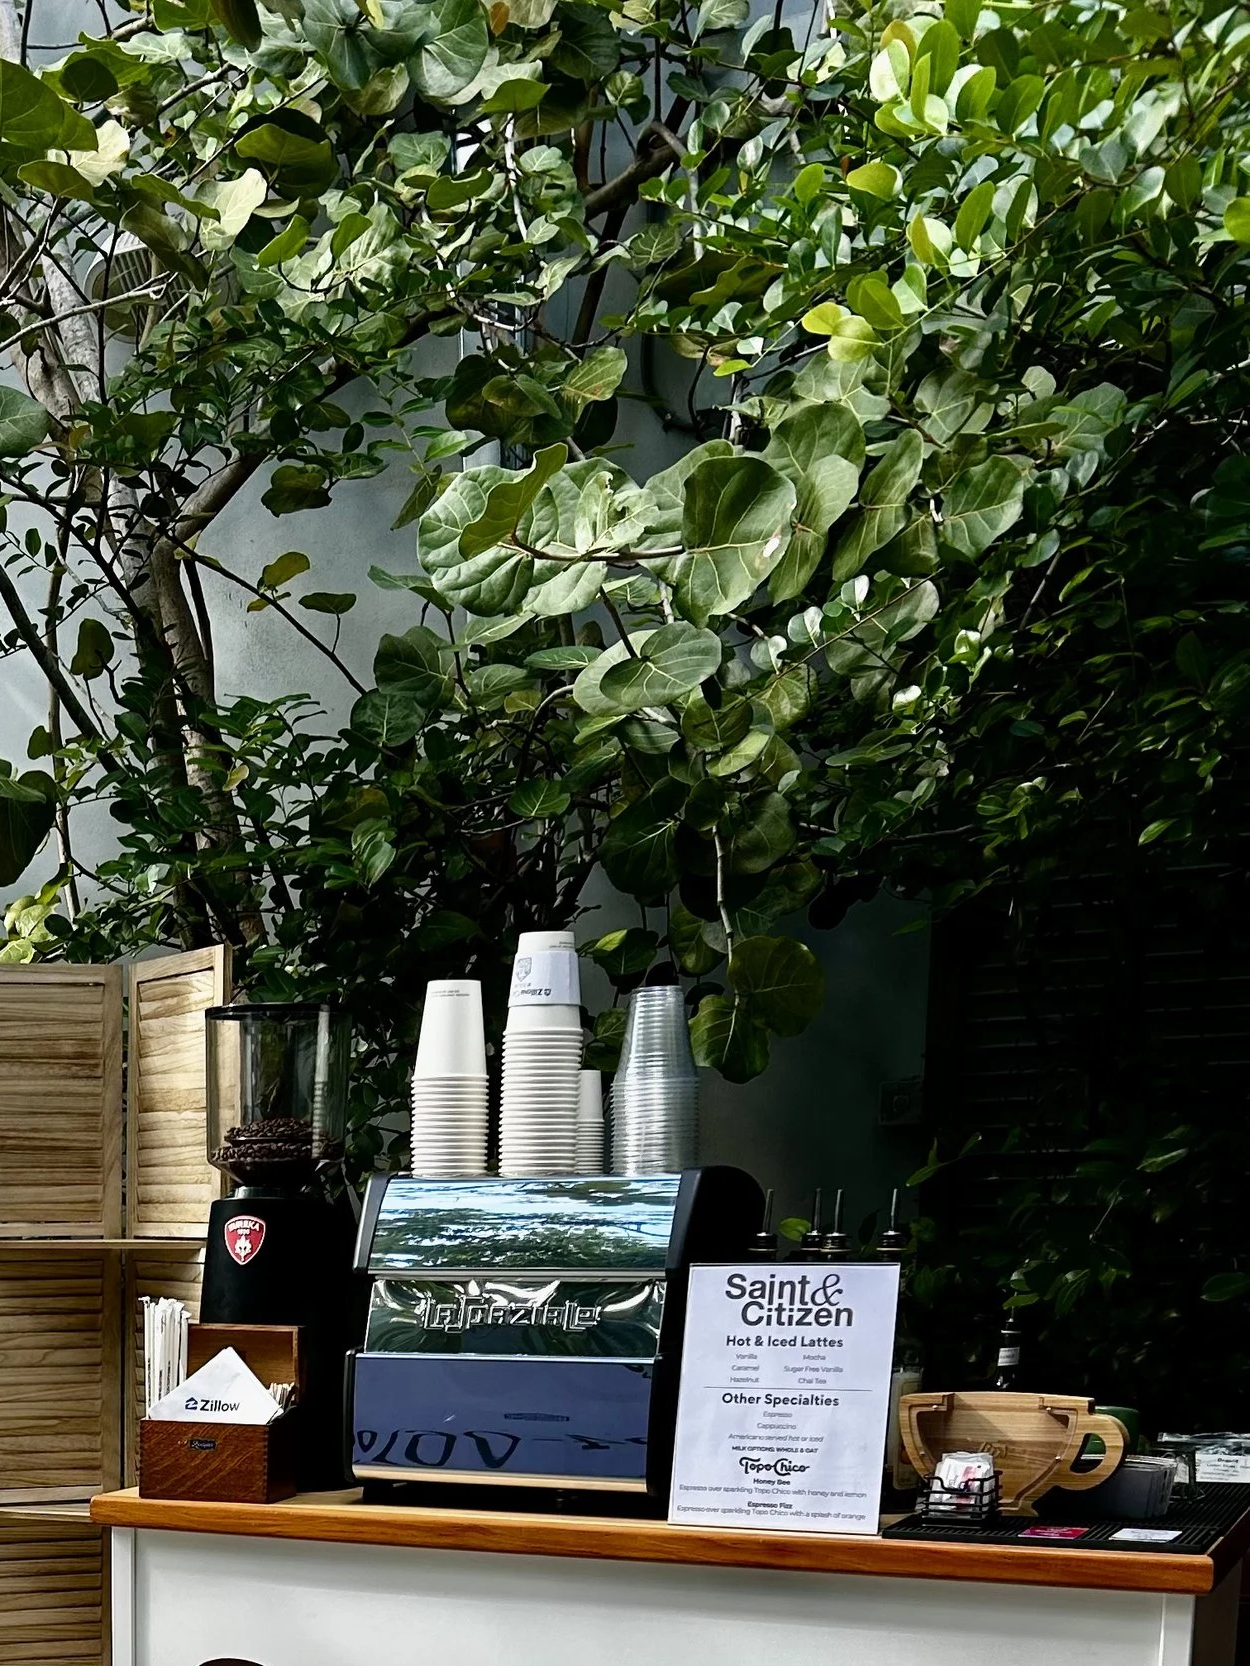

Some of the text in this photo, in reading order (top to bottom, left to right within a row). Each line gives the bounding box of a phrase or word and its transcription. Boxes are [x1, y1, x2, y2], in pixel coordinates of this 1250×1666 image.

[741, 1301, 853, 1326] Citizen
[726, 1335, 844, 1348] Hot & Iced Lattes
[783, 1365, 804, 1374] Sugar
[821, 1366, 844, 1374] Vanilla
[721, 1392, 840, 1407] Other Specialties
[200, 1399, 240, 1412] Zillow
[756, 1422, 797, 1430] Cappuccino
[728, 1433, 764, 1441] Americano
[753, 1478, 776, 1486] Honey
[754, 1487, 770, 1495] Topo
[807, 1490, 830, 1498] honey
[747, 1501, 778, 1509] Espresso
[752, 1508, 769, 1516] Topo
